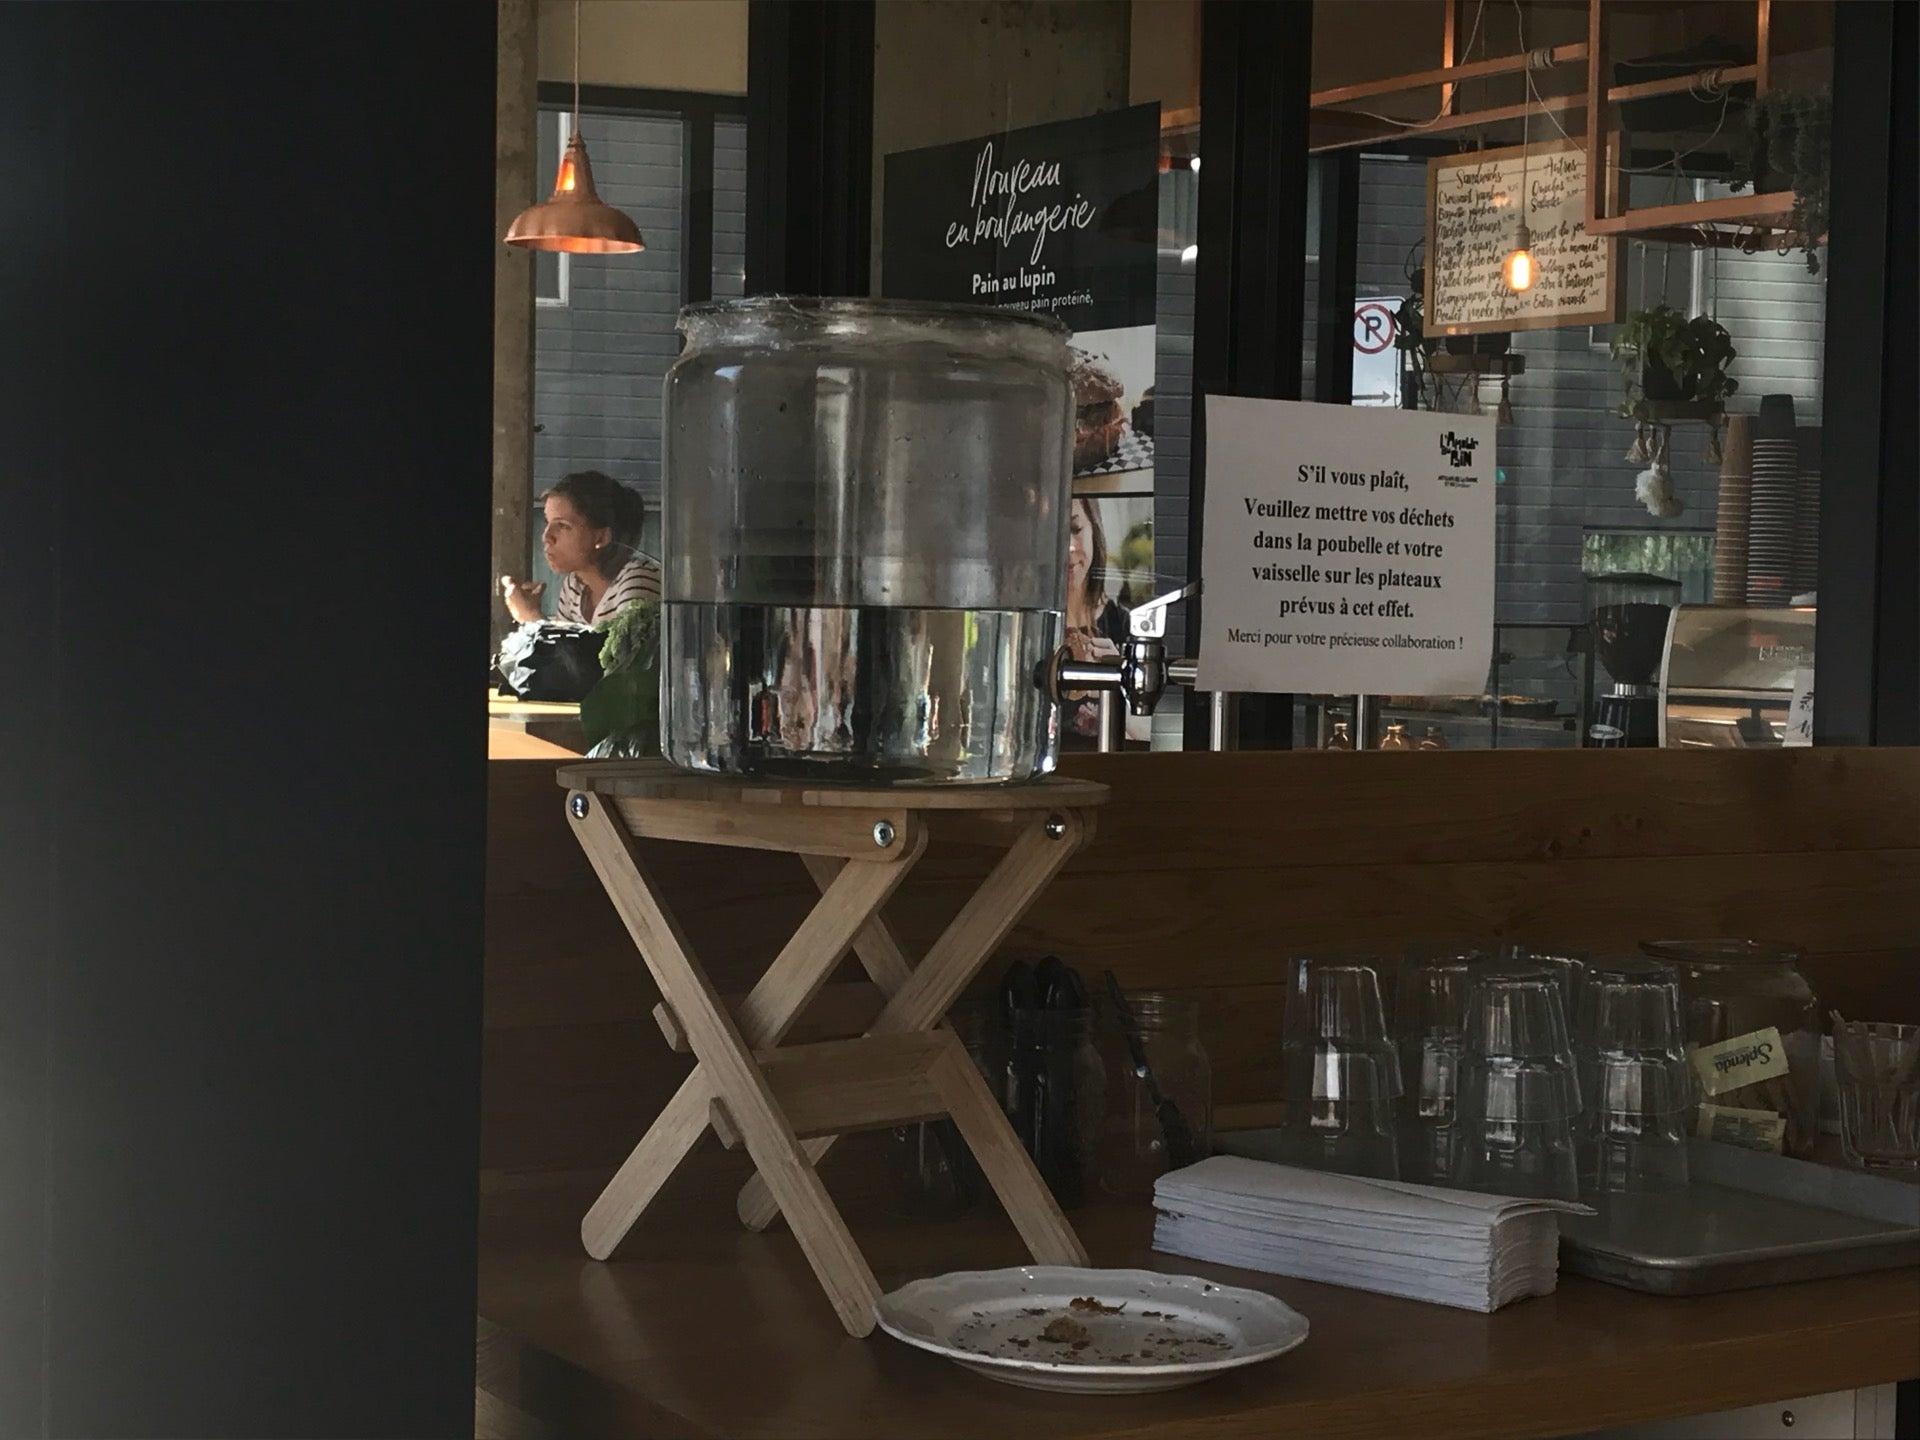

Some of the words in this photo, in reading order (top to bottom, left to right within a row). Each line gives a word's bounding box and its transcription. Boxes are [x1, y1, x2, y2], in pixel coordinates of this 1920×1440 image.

[971, 142, 1060, 207] Nouveau
[946, 220, 970, 248] en
[973, 193, 1096, 265] boulangerie
[1571, 222, 1585, 241] jou
[972, 273, 999, 295] Pain
[1003, 275, 1016, 290] au
[1020, 266, 1056, 295] lupin
[1031, 294, 1049, 311] pain
[1052, 289, 1093, 312] protéiné,
[1331, 472, 1365, 486] vous
[1244, 498, 1310, 519] Veuillez
[1316, 506, 1368, 523] mettre
[1372, 510, 1395, 525] vos
[1399, 508, 1454, 528] déchets
[1254, 532, 1292, 550] dans
[1298, 533, 1312, 551] la
[1317, 535, 1383, 556] poubelle
[1387, 538, 1400, 555] et
[1405, 541, 1443, 557] votre
[1252, 564, 1320, 583] vaisselle
[1325, 569, 1351, 584] sur
[1355, 567, 1374, 586] les
[1379, 569, 1441, 590] plateaux
[1280, 597, 1334, 617] prévus
[1340, 598, 1348, 615] à
[1353, 600, 1374, 616] cet
[1378, 600, 1414, 617] effet.
[1228, 629, 1261, 644] Merci
[1265, 632, 1292, 647] pour
[1296, 633, 1326, 645] votre
[1330, 633, 1379, 648] précieuse
[1383, 635, 1455, 649] collaboration
[1458, 636, 1463, 649] !
[1715, 1043, 1772, 1073] Splenda
